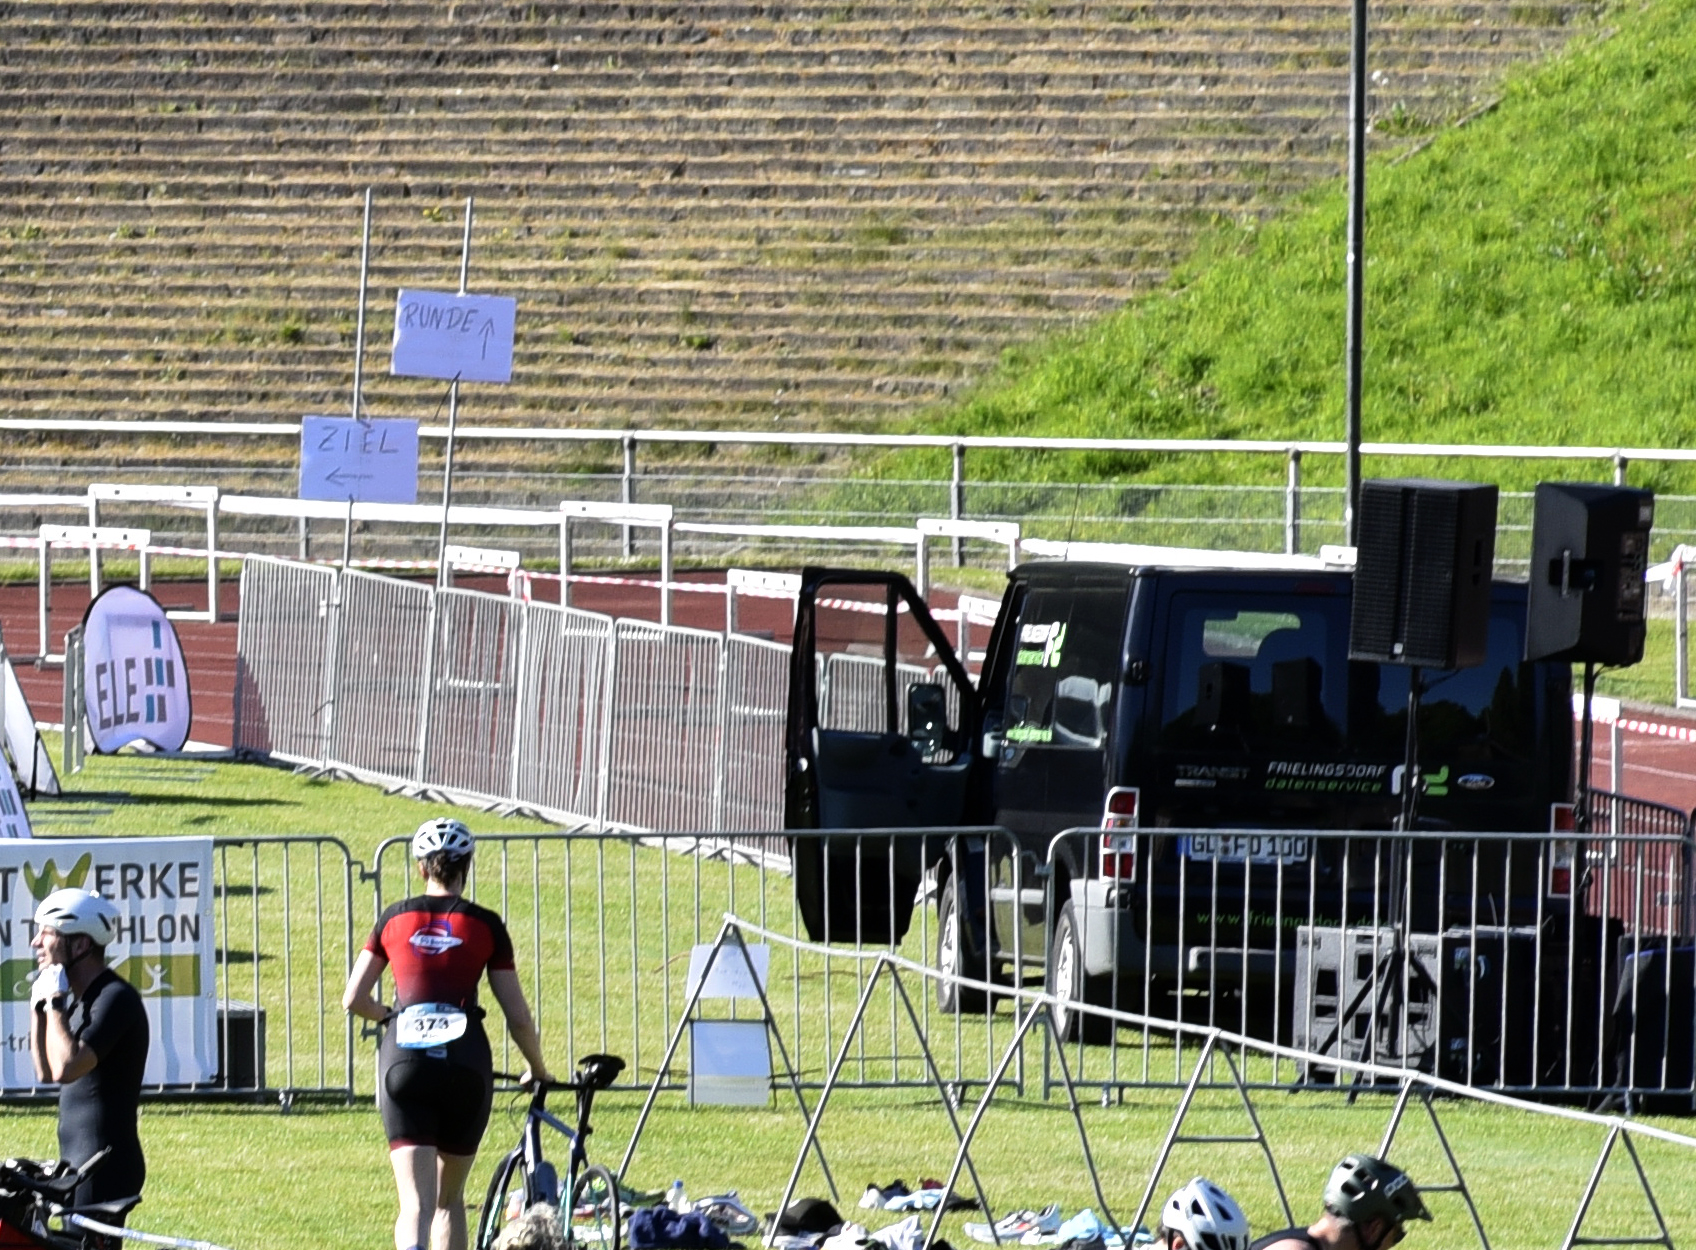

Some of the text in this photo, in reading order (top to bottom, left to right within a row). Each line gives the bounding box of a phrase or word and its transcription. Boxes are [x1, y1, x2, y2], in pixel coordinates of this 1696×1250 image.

[402, 302, 479, 333] RUNDE
[319, 426, 400, 454] ZIEL
[96, 657, 139, 730] ELE
[1267, 761, 1387, 778] FRIELINGSDORF
[1265, 777, 1383, 793] datenservice
[21, 914, 201, 946] THLON
